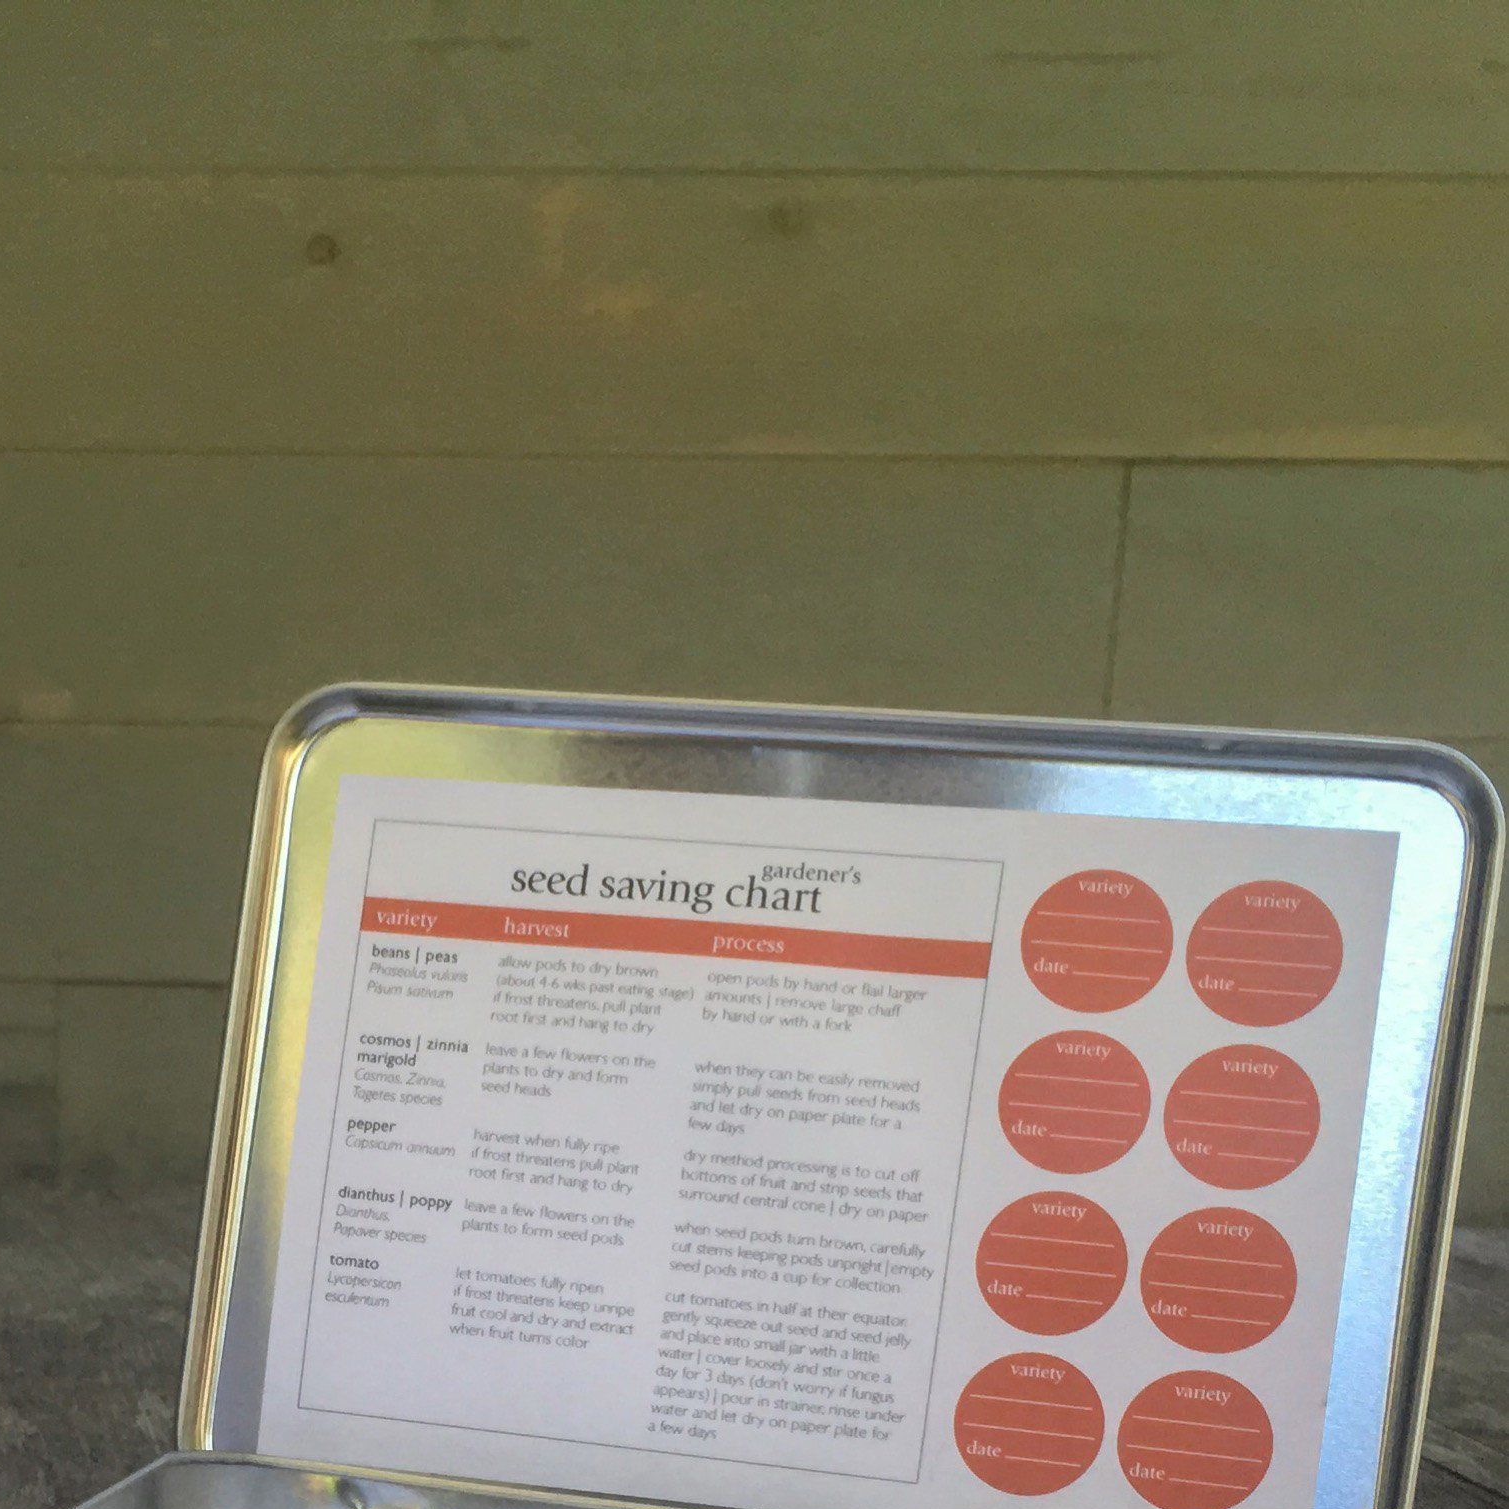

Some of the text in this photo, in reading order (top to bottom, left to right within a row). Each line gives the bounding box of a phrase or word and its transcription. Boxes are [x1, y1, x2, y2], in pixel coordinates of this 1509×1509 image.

[761, 862, 861, 885] gardener's
[511, 863, 822, 914] seed saving chart
[1078, 879, 1134, 898] variety
[1244, 894, 1300, 912] variety
[377, 909, 785, 954] variety harvest process
[372, 945, 457, 965] beans peas
[1034, 957, 1069, 974] date
[1198, 975, 1234, 991] date
[360, 1035, 468, 1051] cosmos zinnia
[1056, 1042, 1111, 1060] variety
[358, 1051, 416, 1067] marigold
[1222, 1059, 1278, 1078] variety
[347, 1119, 396, 1134] pepper
[1011, 1120, 1047, 1137] date
[1176, 1139, 1213, 1156] date
[338, 1185, 453, 1211] dianthus poppy
[1032, 1201, 1086, 1220] variety
[1197, 1221, 1254, 1241] variety
[330, 1254, 379, 1269] tomato
[987, 1279, 1023, 1296] date
[1151, 1300, 1187, 1317] date
[1010, 1363, 1065, 1383] variety
[1174, 1385, 1231, 1405] variety
[966, 1441, 1001, 1458] date
[1130, 1463, 1165, 1480] date
